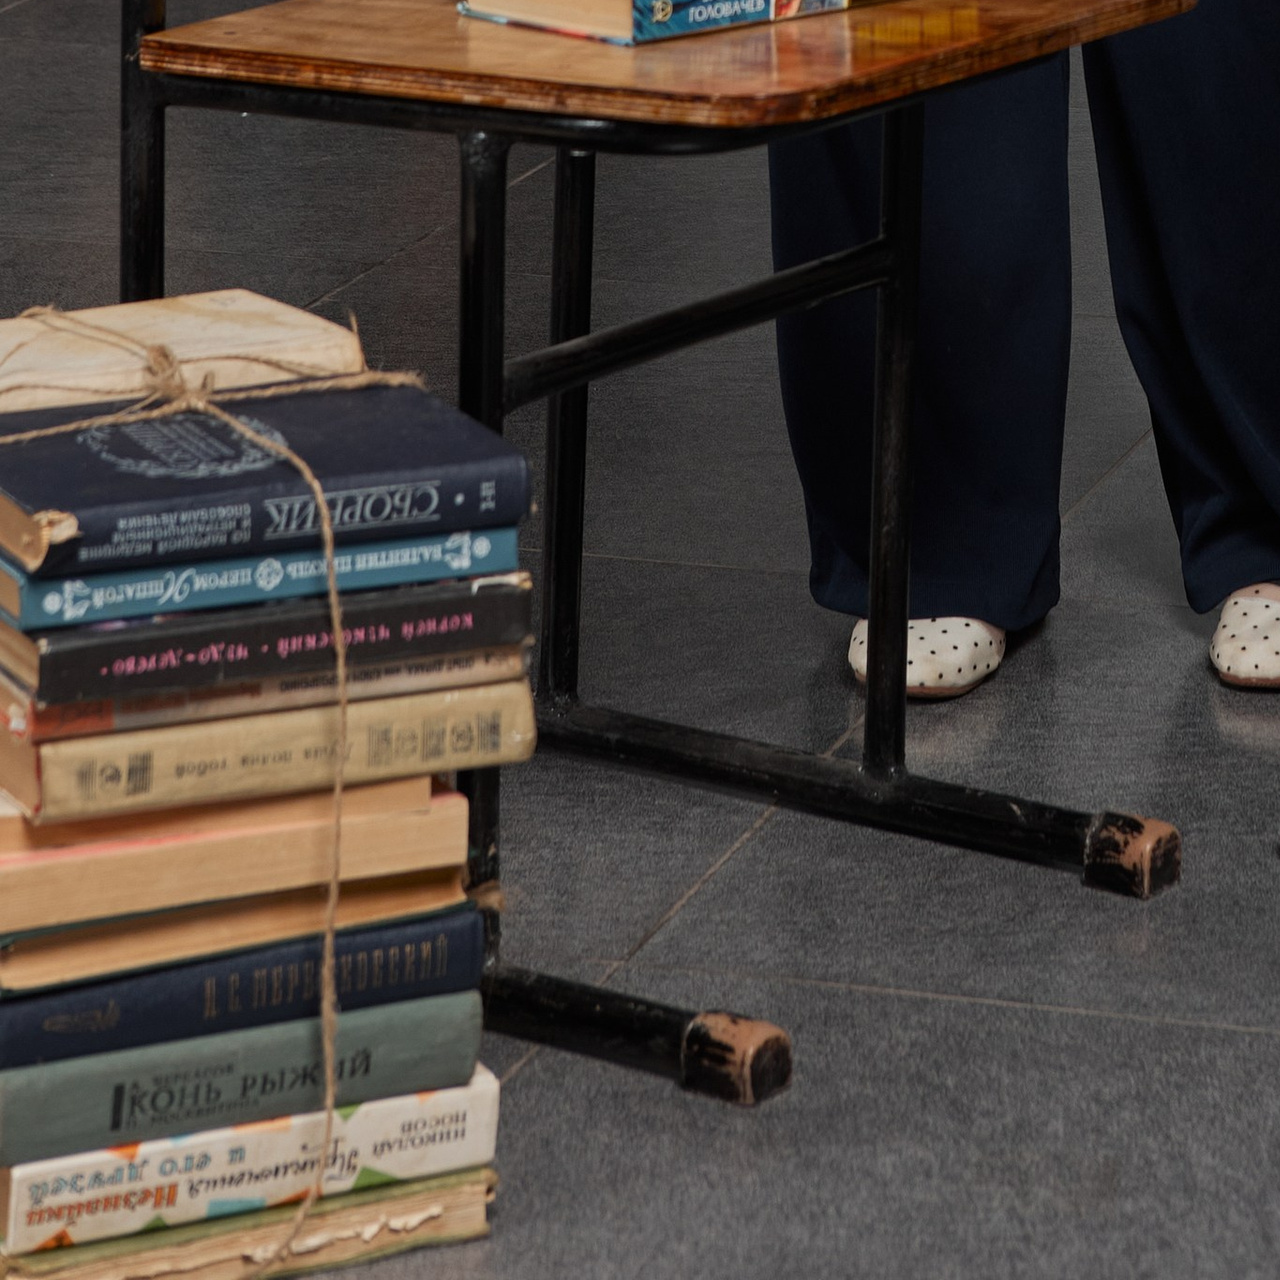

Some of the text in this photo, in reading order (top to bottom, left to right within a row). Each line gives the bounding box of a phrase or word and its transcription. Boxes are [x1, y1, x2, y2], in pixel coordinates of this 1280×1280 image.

[253, 934, 449, 1008] МЕРЕКОВСКИЙ
[130, 1080, 222, 1116] КОНЬ
[400, 1110, 468, 1136] НОСОВ
[371, 1126, 467, 1157] НИКОЛАЙ
[158, 1153, 212, 1179] его
[26, 1183, 178, 1228] Незнайки
